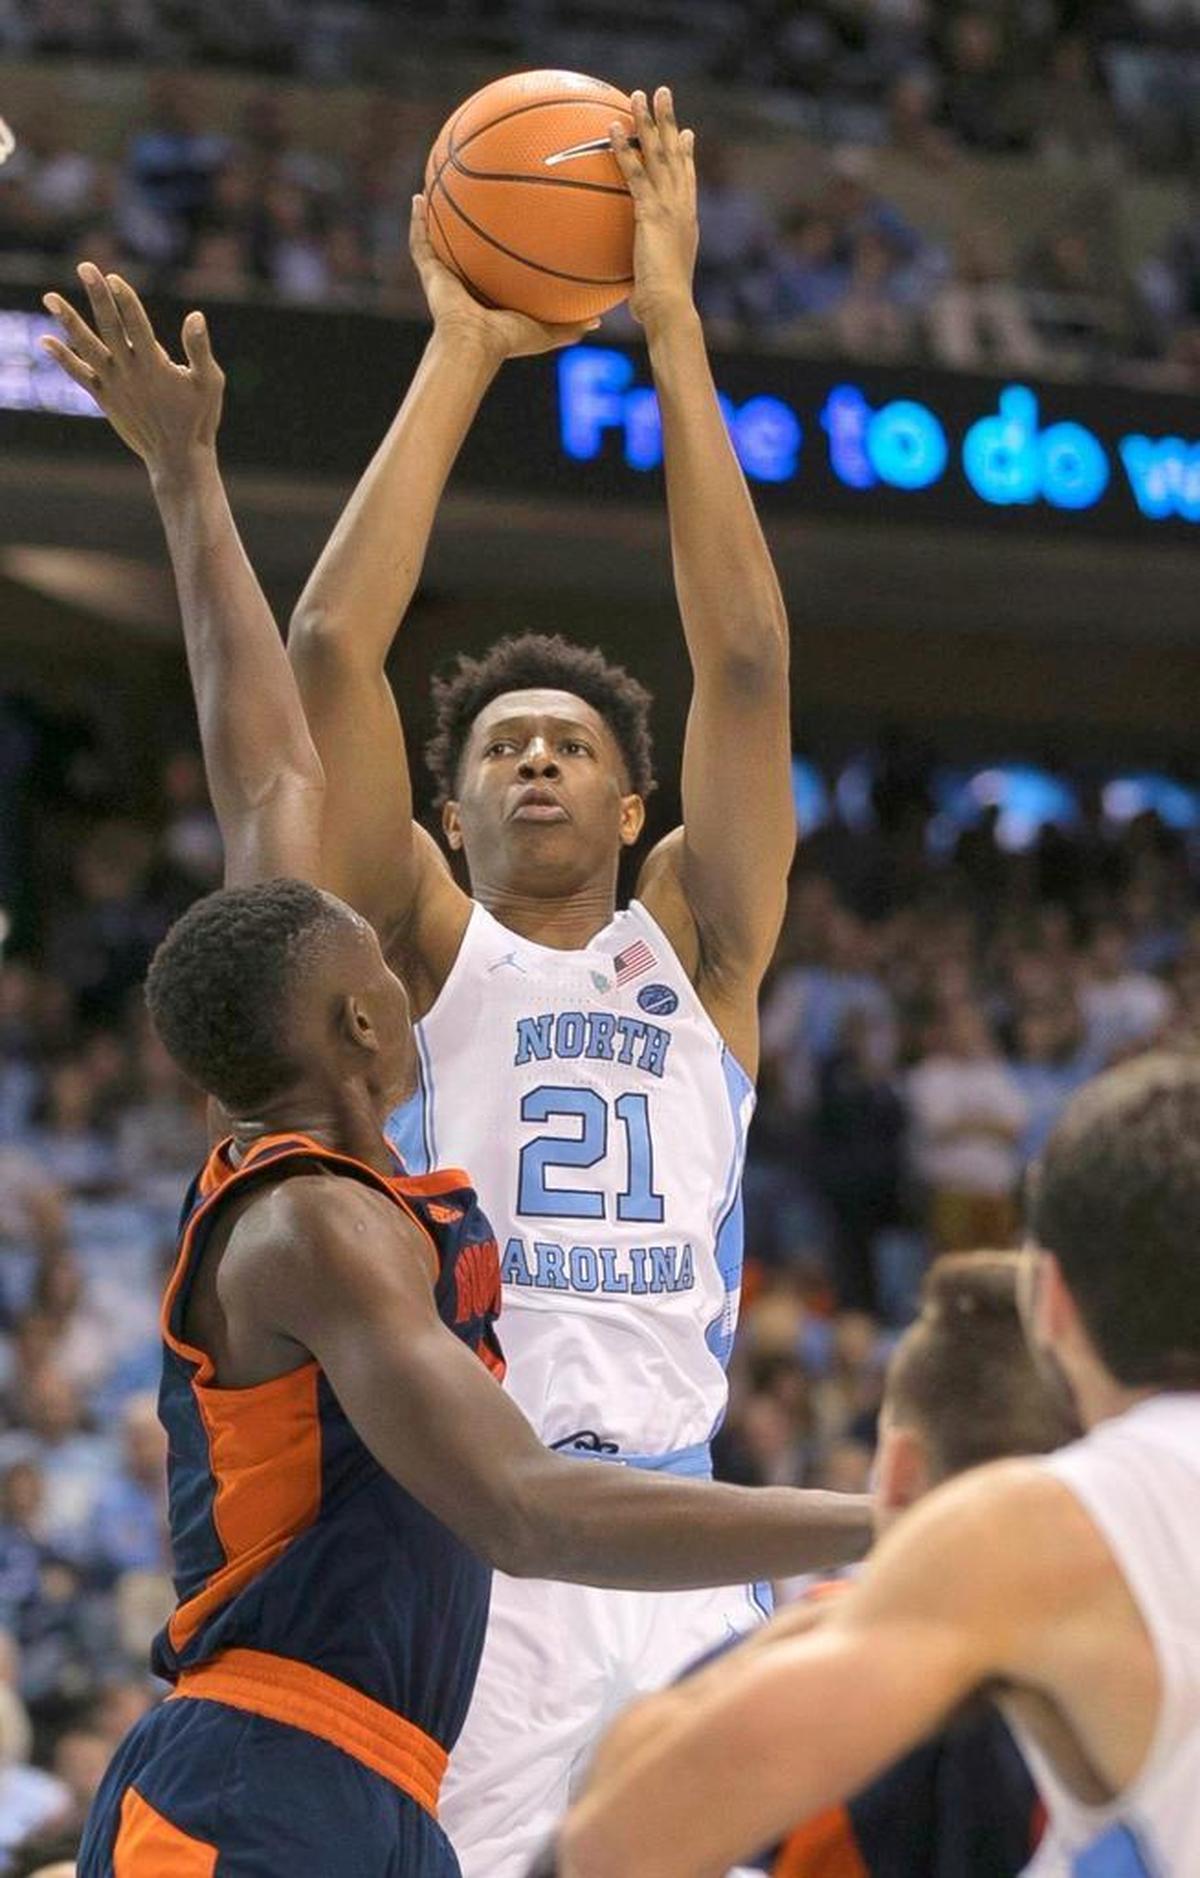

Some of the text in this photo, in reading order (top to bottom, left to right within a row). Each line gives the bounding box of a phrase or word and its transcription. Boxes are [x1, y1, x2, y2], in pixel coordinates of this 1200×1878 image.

[820, 382, 948, 491] to
[962, 382, 1110, 509] do
[514, 1012, 672, 1078] NORTH
[516, 1085, 664, 1223] 21
[500, 1238, 695, 1295] AROLINA
